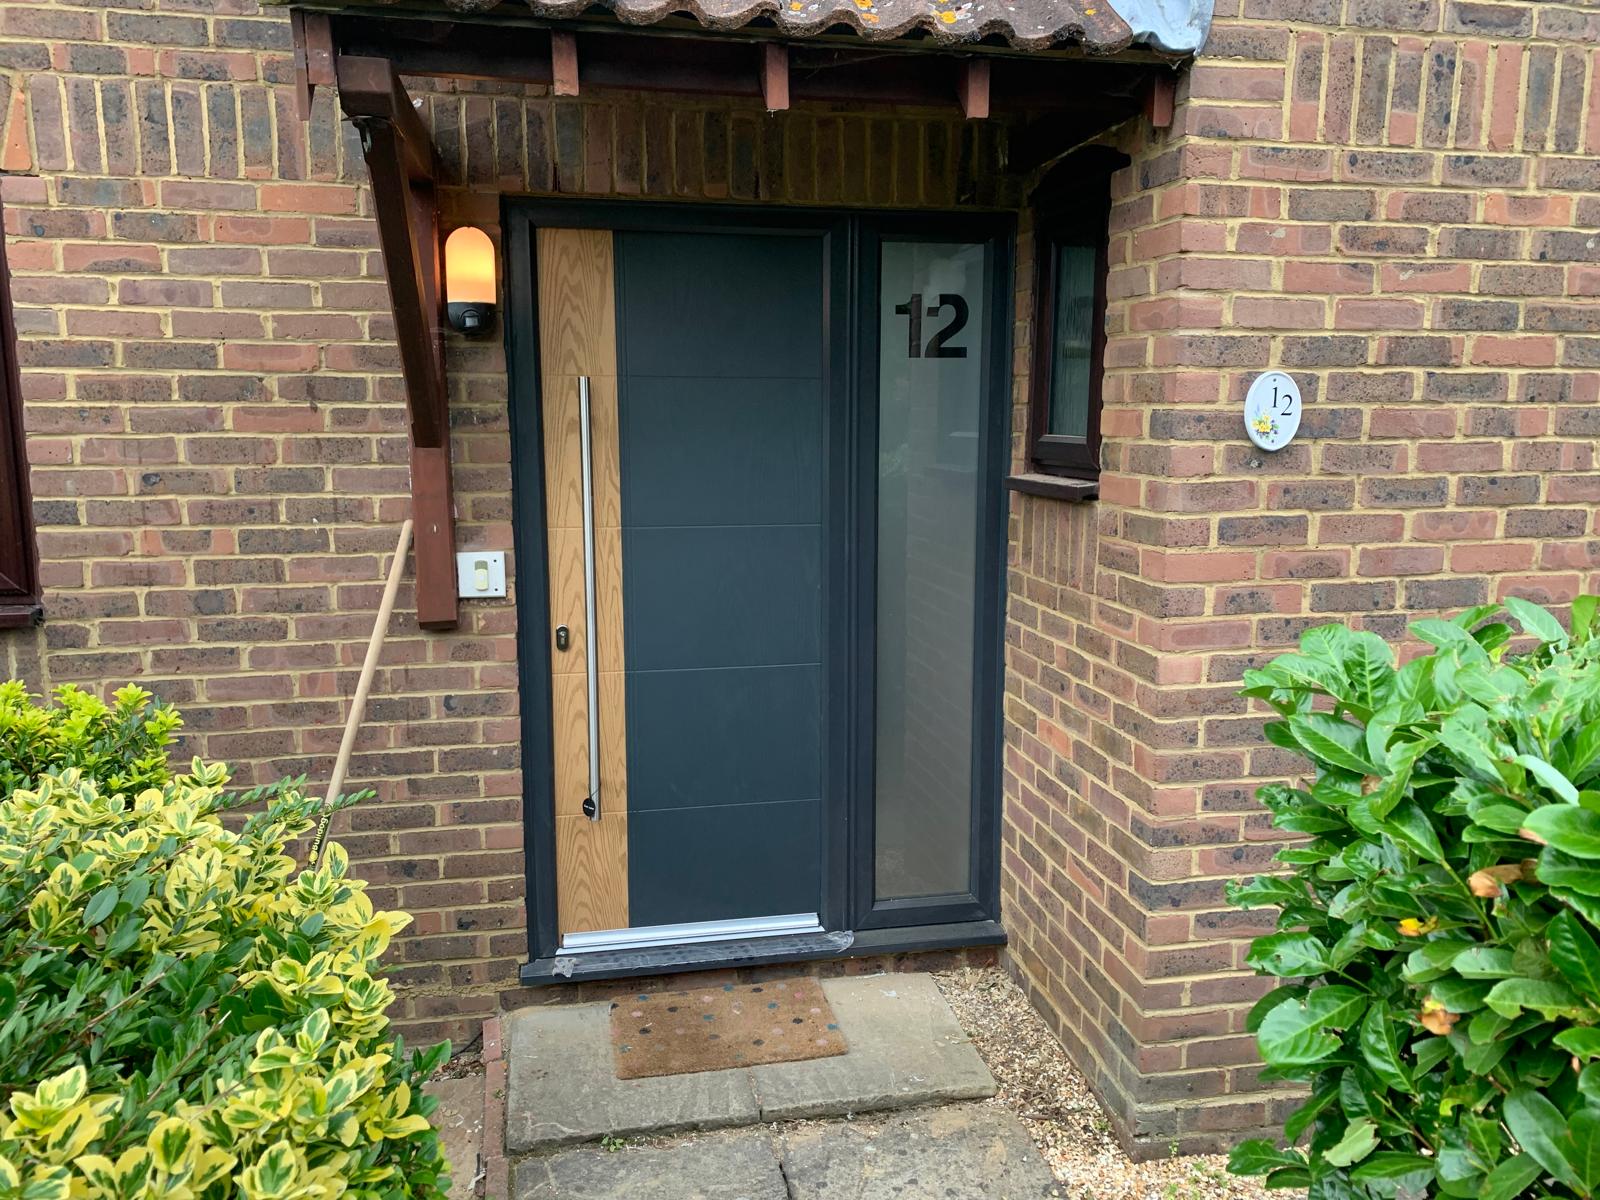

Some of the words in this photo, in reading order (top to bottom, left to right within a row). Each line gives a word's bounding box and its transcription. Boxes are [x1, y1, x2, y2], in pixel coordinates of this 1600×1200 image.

[895, 294, 969, 358] 12
[1272, 386, 1293, 416] 12
[311, 816, 329, 851] Bulldog
